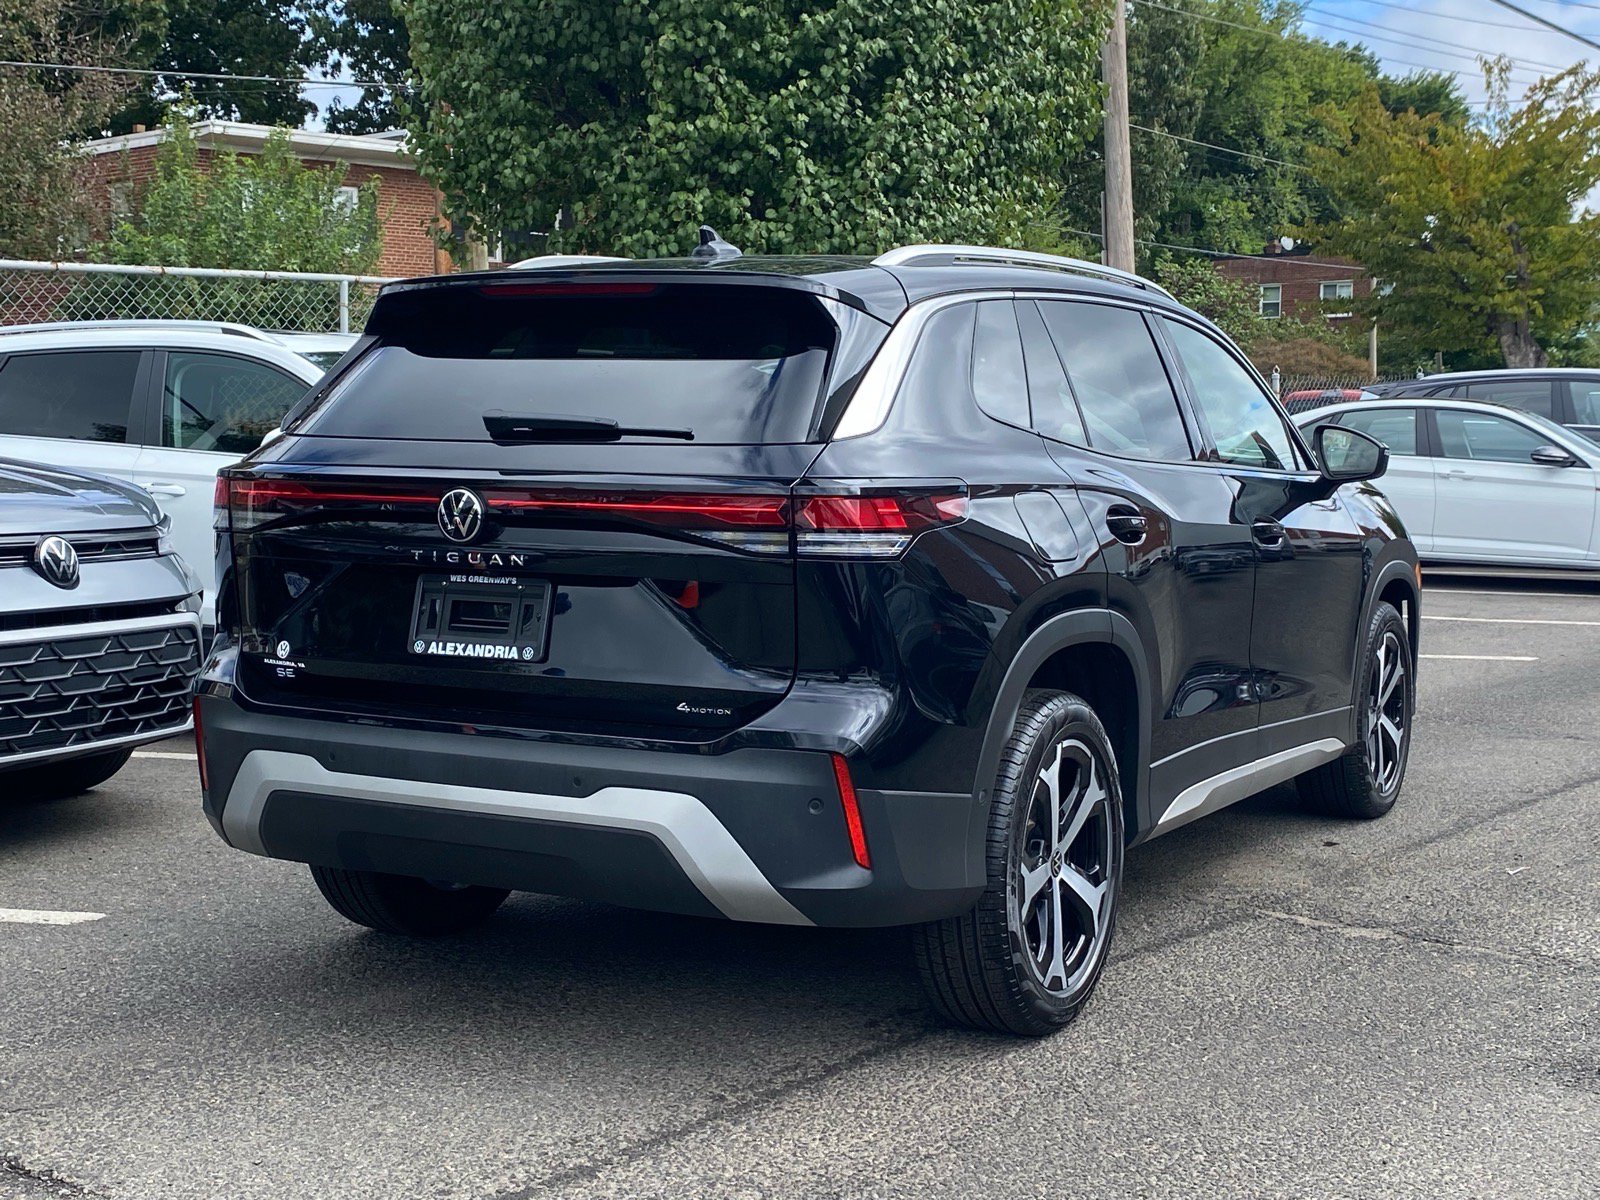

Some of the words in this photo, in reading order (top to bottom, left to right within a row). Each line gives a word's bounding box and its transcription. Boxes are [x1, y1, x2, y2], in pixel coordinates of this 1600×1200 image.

[411, 550, 525, 566] TIGUAN
[450, 574, 467, 583] WES
[468, 575, 517, 585] GREENWAY'S
[427, 641, 519, 660] ALEXANDRIA
[276, 667, 295, 677] SE
[676, 702, 731, 715] 4MOTION
